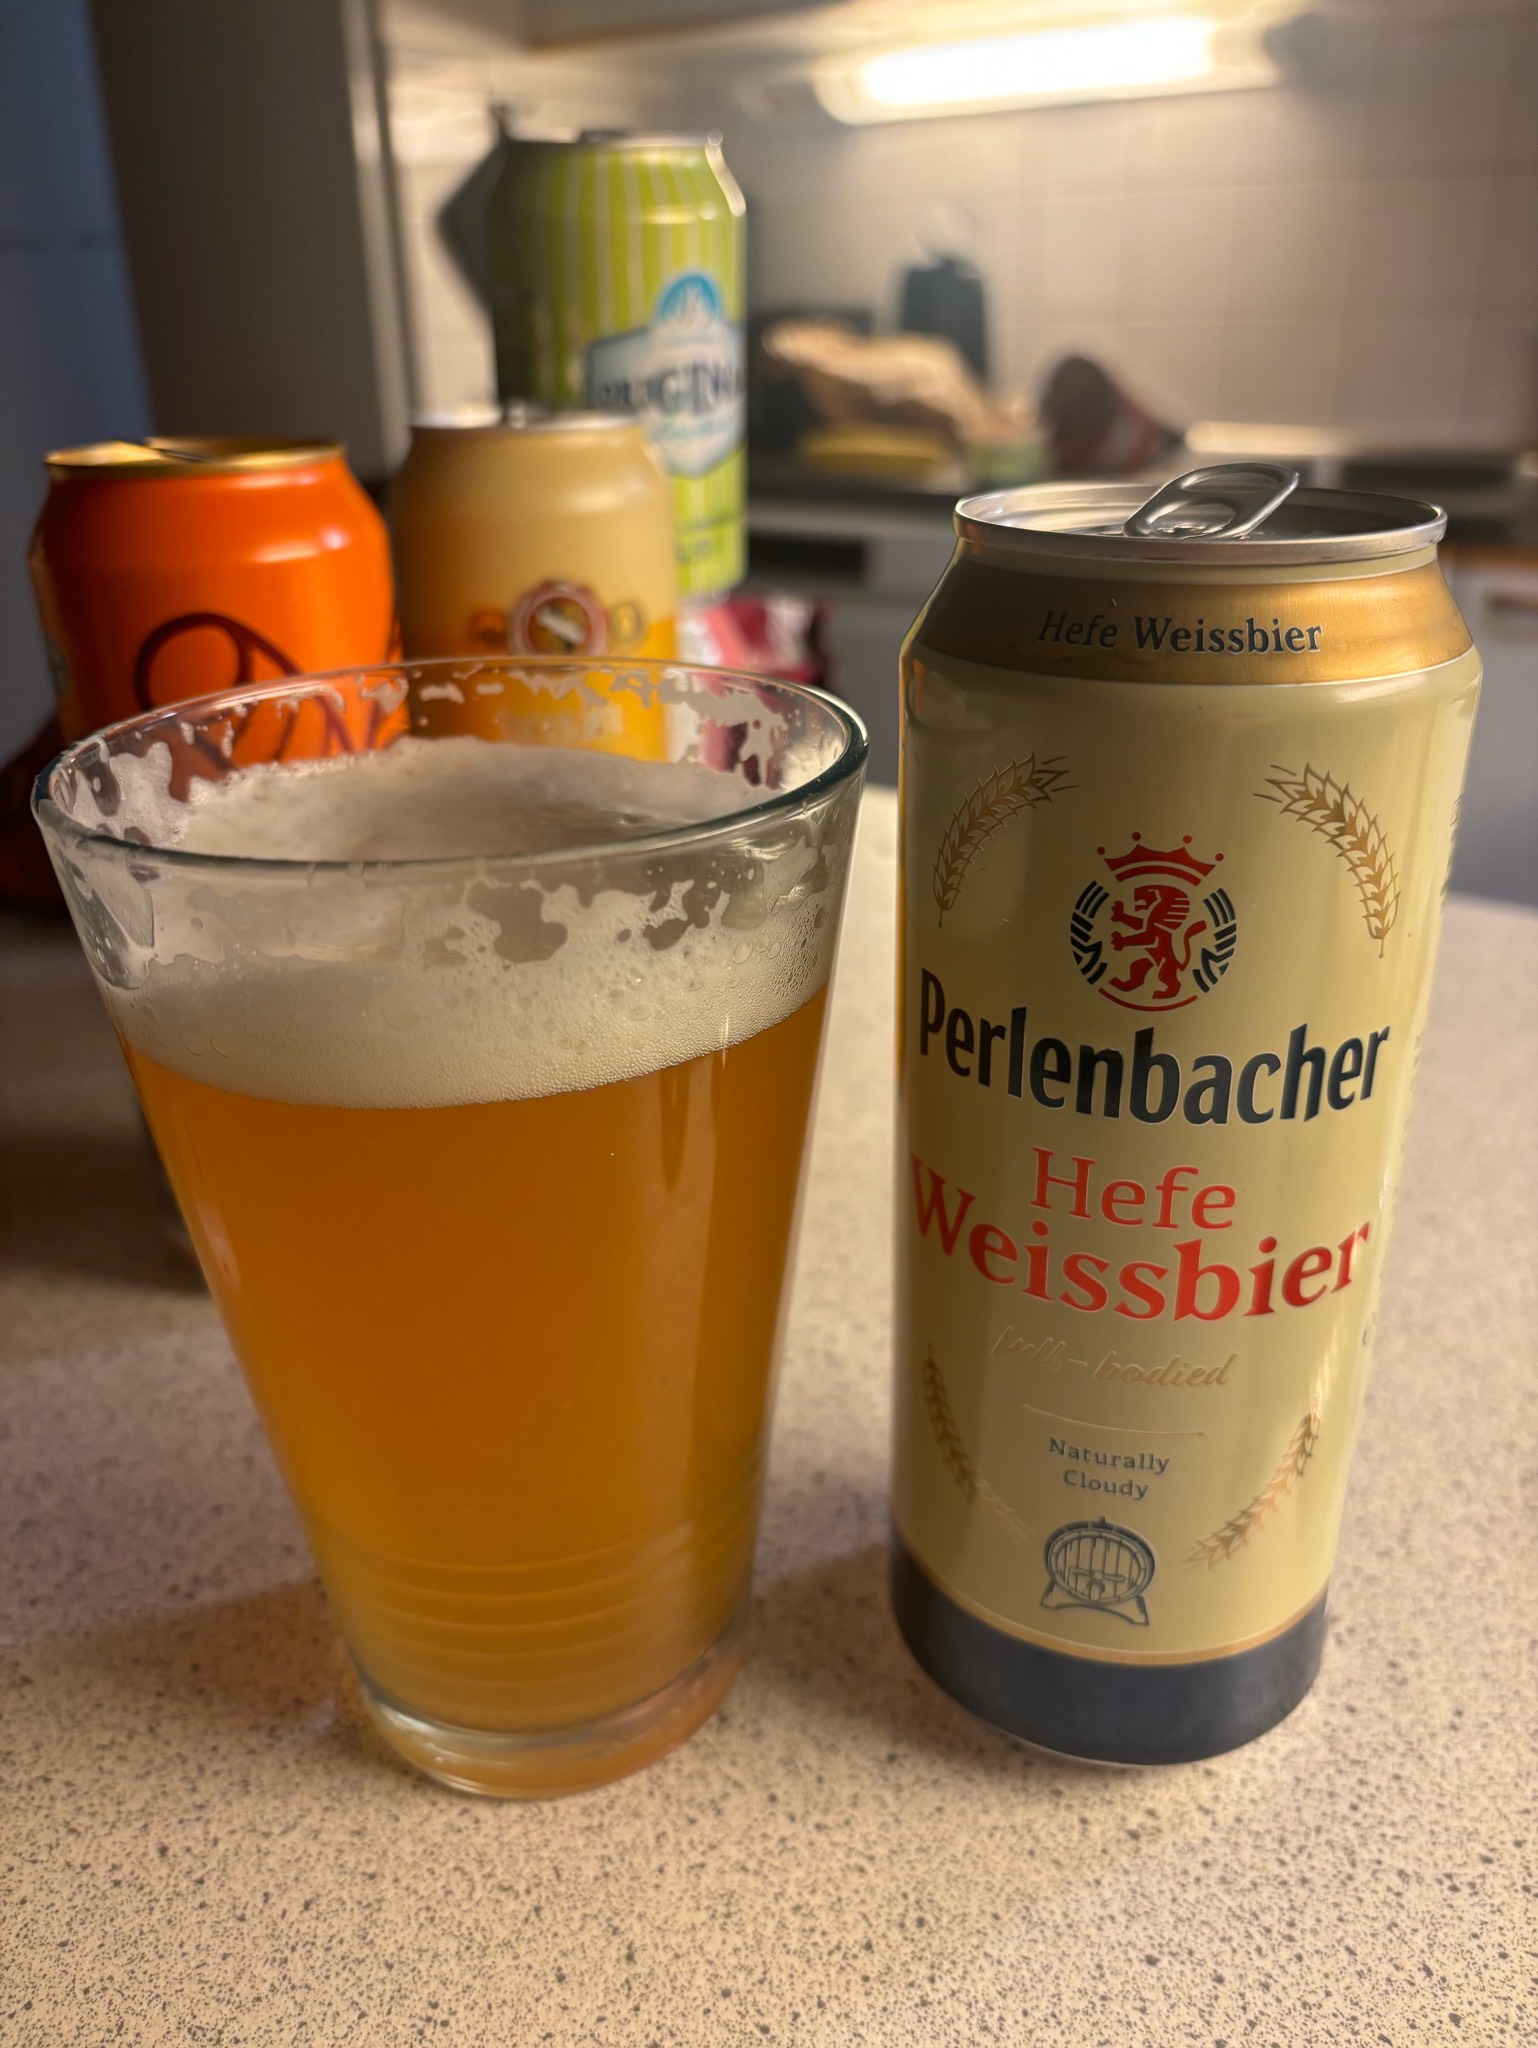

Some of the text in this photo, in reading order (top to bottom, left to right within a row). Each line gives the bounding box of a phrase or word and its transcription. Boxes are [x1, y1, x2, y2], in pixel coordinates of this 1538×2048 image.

[1037, 610, 1321, 654] Hefe Weissbier
[920, 966, 1391, 1126] Perlenbacher
[1030, 1146, 1237, 1230] Hefe
[909, 1151, 1370, 1322] Weissbier
[1048, 1436, 1170, 1474] Naturally
[1062, 1469, 1150, 1500] Cloudy
